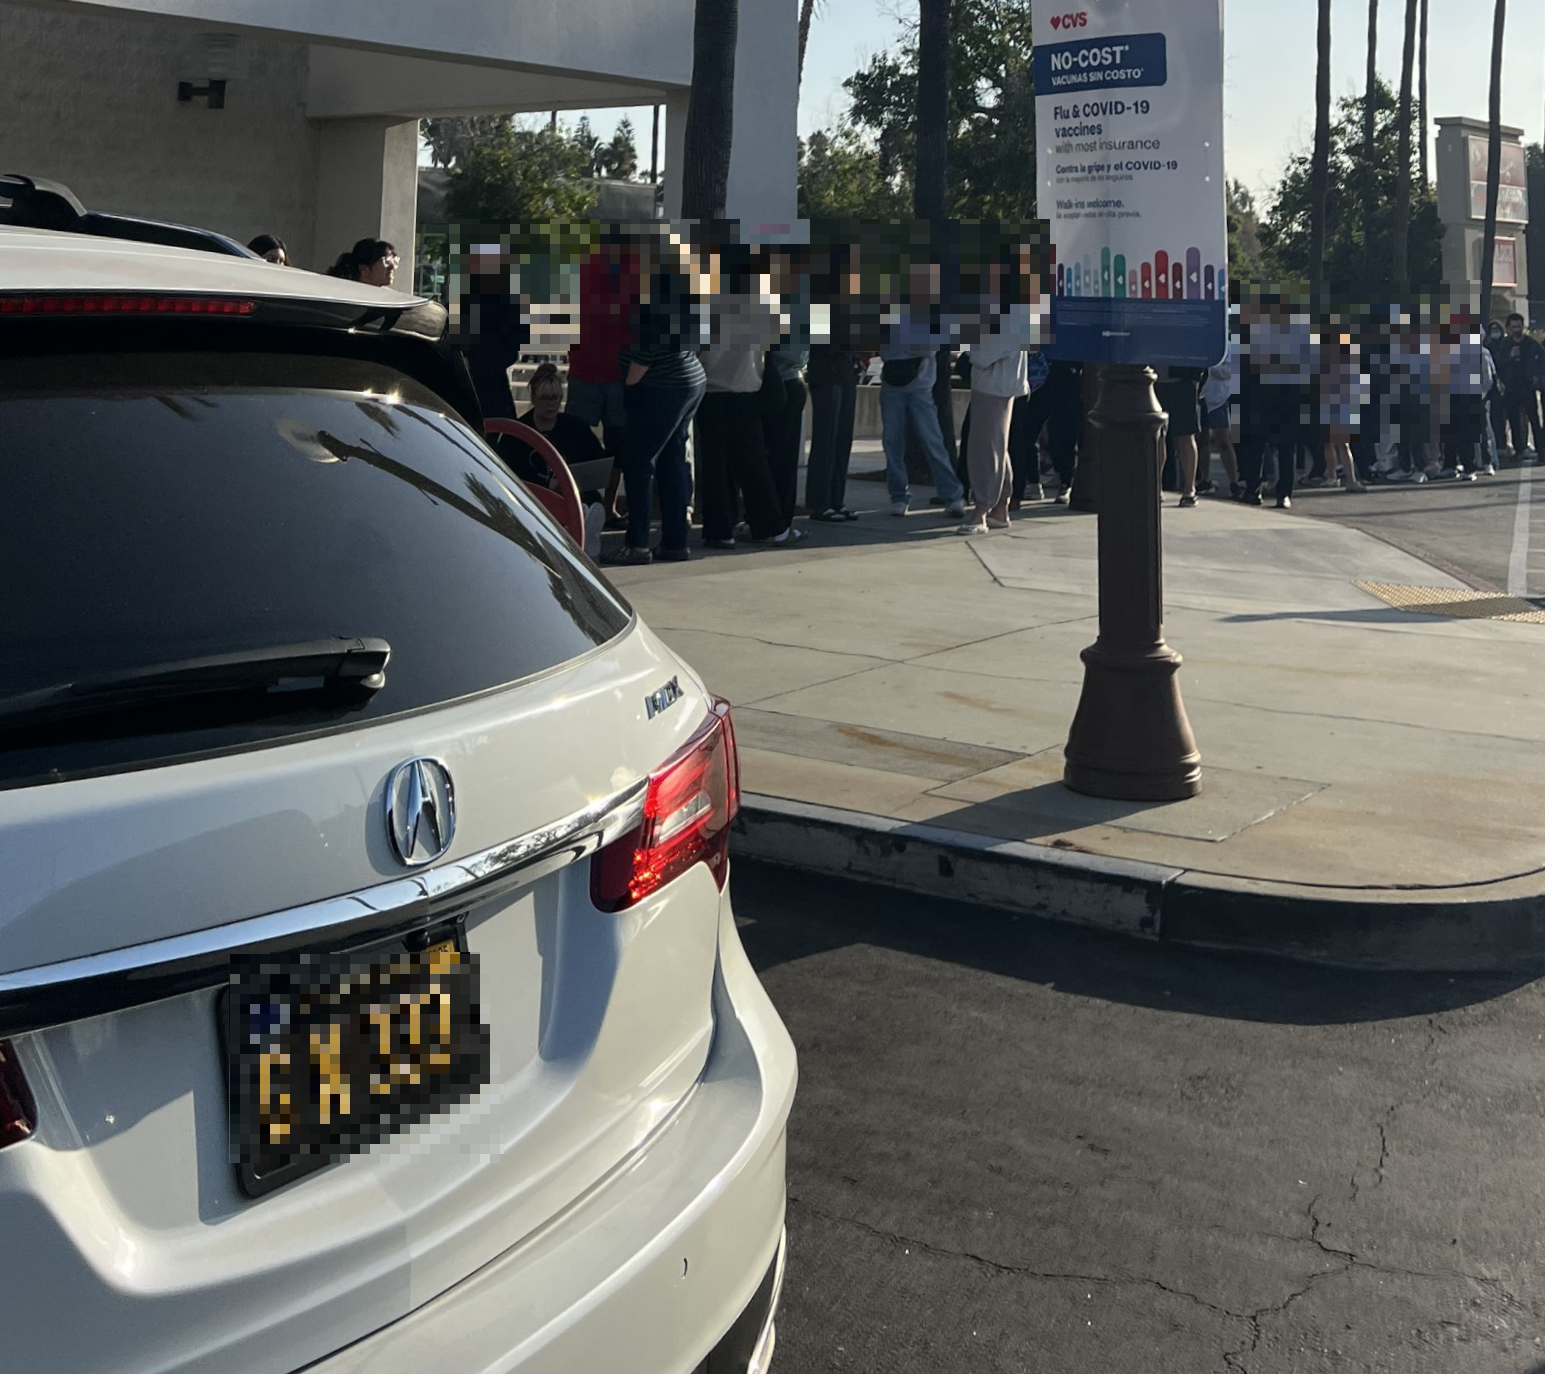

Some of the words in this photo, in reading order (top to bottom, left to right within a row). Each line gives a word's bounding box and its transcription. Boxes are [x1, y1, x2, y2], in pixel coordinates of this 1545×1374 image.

[1062, 12, 1088, 30] CVS
[1051, 72, 1088, 86] VACUNAS
[1089, 71, 1103, 82] SIN
[1054, 105, 1070, 120] Flu
[1072, 104, 1081, 118] &
[1082, 100, 1150, 117] COVID-19
[1055, 122, 1103, 138] vaccines
[1056, 140, 1073, 154] with
[1075, 140, 1097, 152] most
[1099, 137, 1160, 151] insurance
[1056, 164, 1079, 174] Contra
[1080, 163, 1086, 173] la
[1087, 162, 1105, 174] gripe
[1106, 164, 1111, 173] y
[1114, 161, 1123, 171] el
[1125, 160, 1178, 171] COVID-19
[1056, 197, 1085, 209] Walk-ins
[1087, 197, 1125, 209] welcome.
[645, 675, 684, 720] MDX
